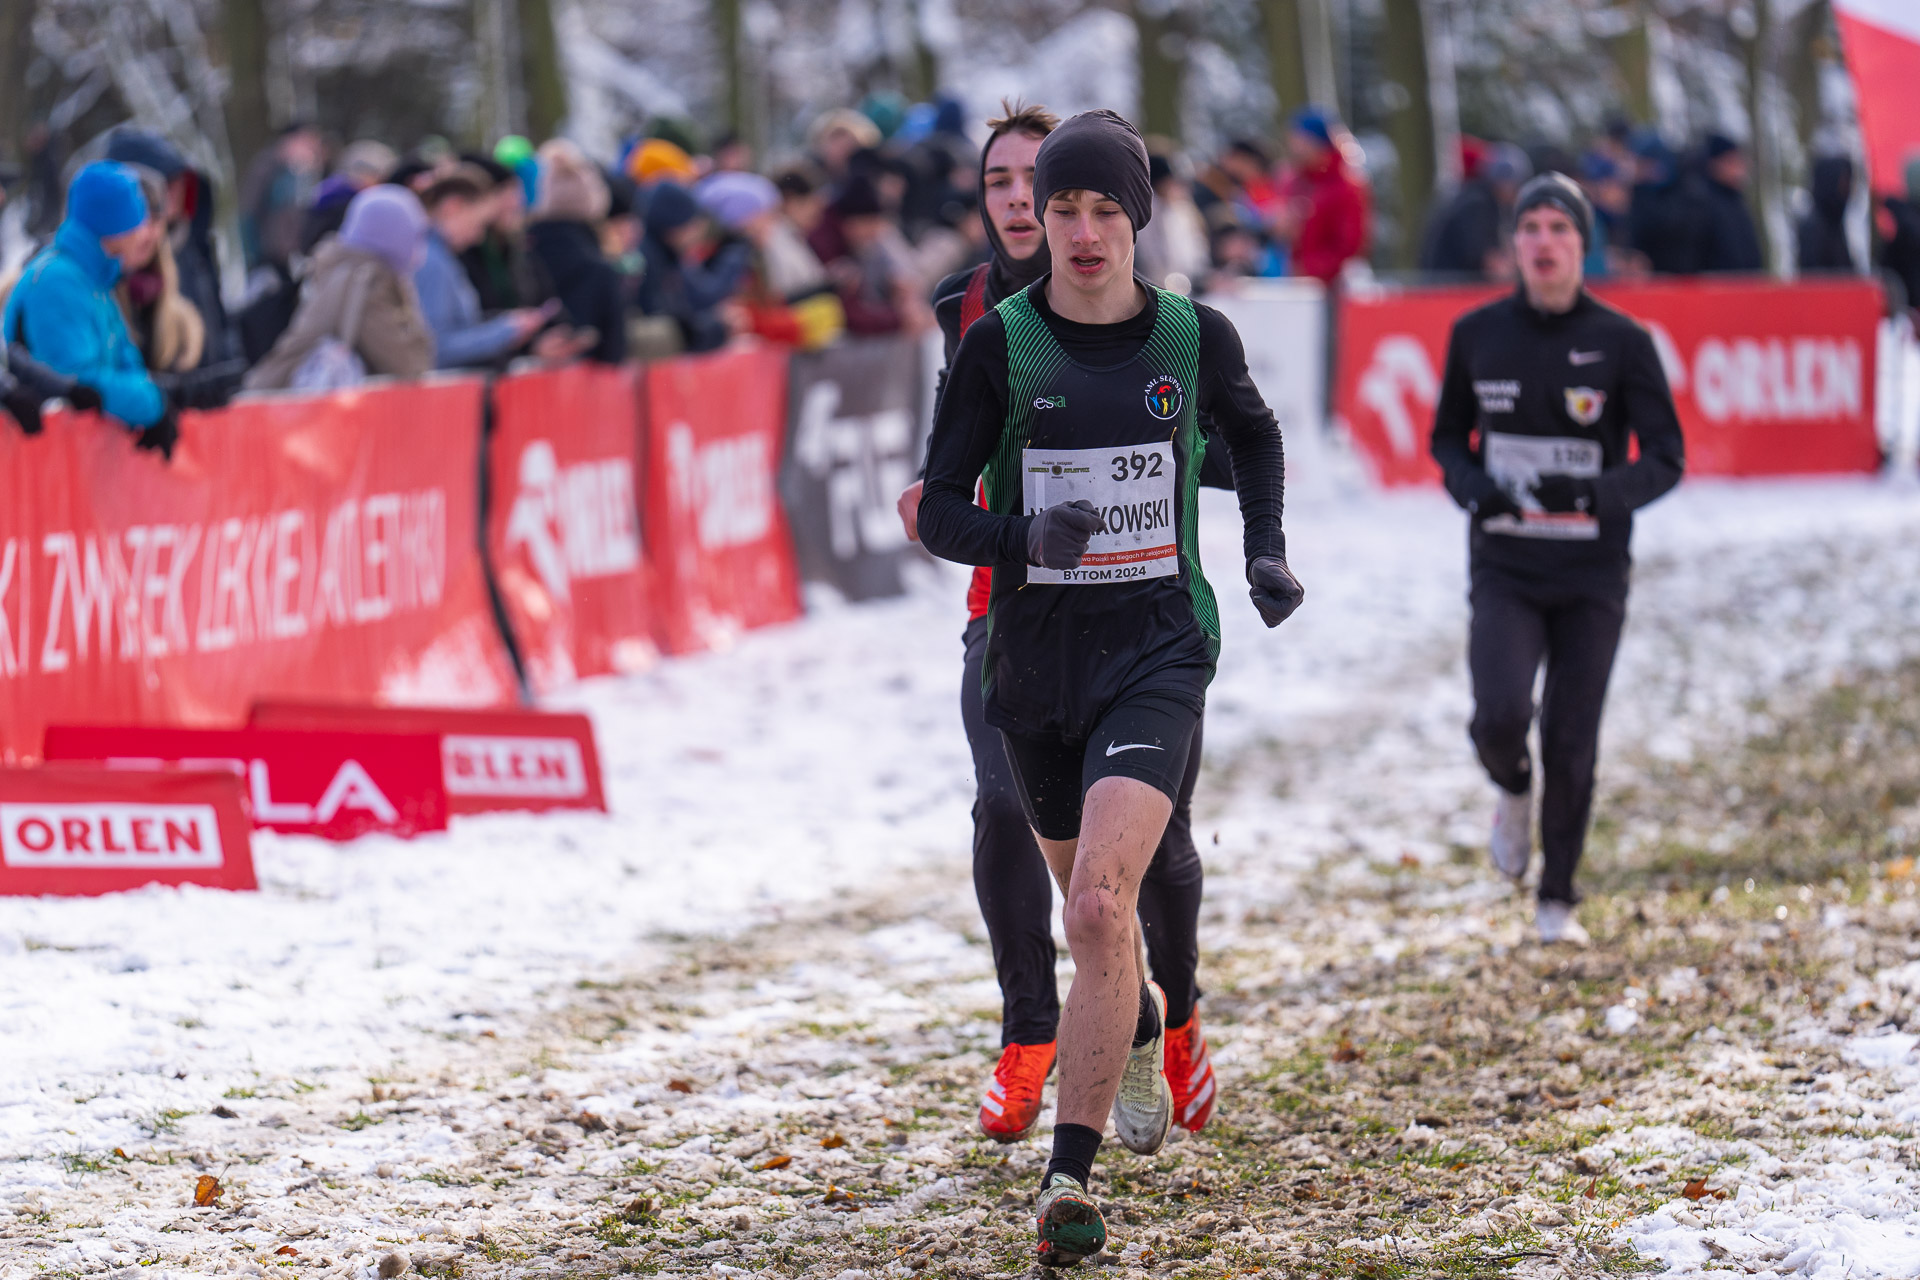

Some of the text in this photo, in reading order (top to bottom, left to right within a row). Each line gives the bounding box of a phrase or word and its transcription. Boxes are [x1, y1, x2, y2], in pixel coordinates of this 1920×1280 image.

[1697, 338, 1863, 420] ORLEN
[1111, 452, 1163, 481] 392
[1063, 565, 1147, 581] BYTOM 2024
[15, 816, 201, 854] ORLEN
